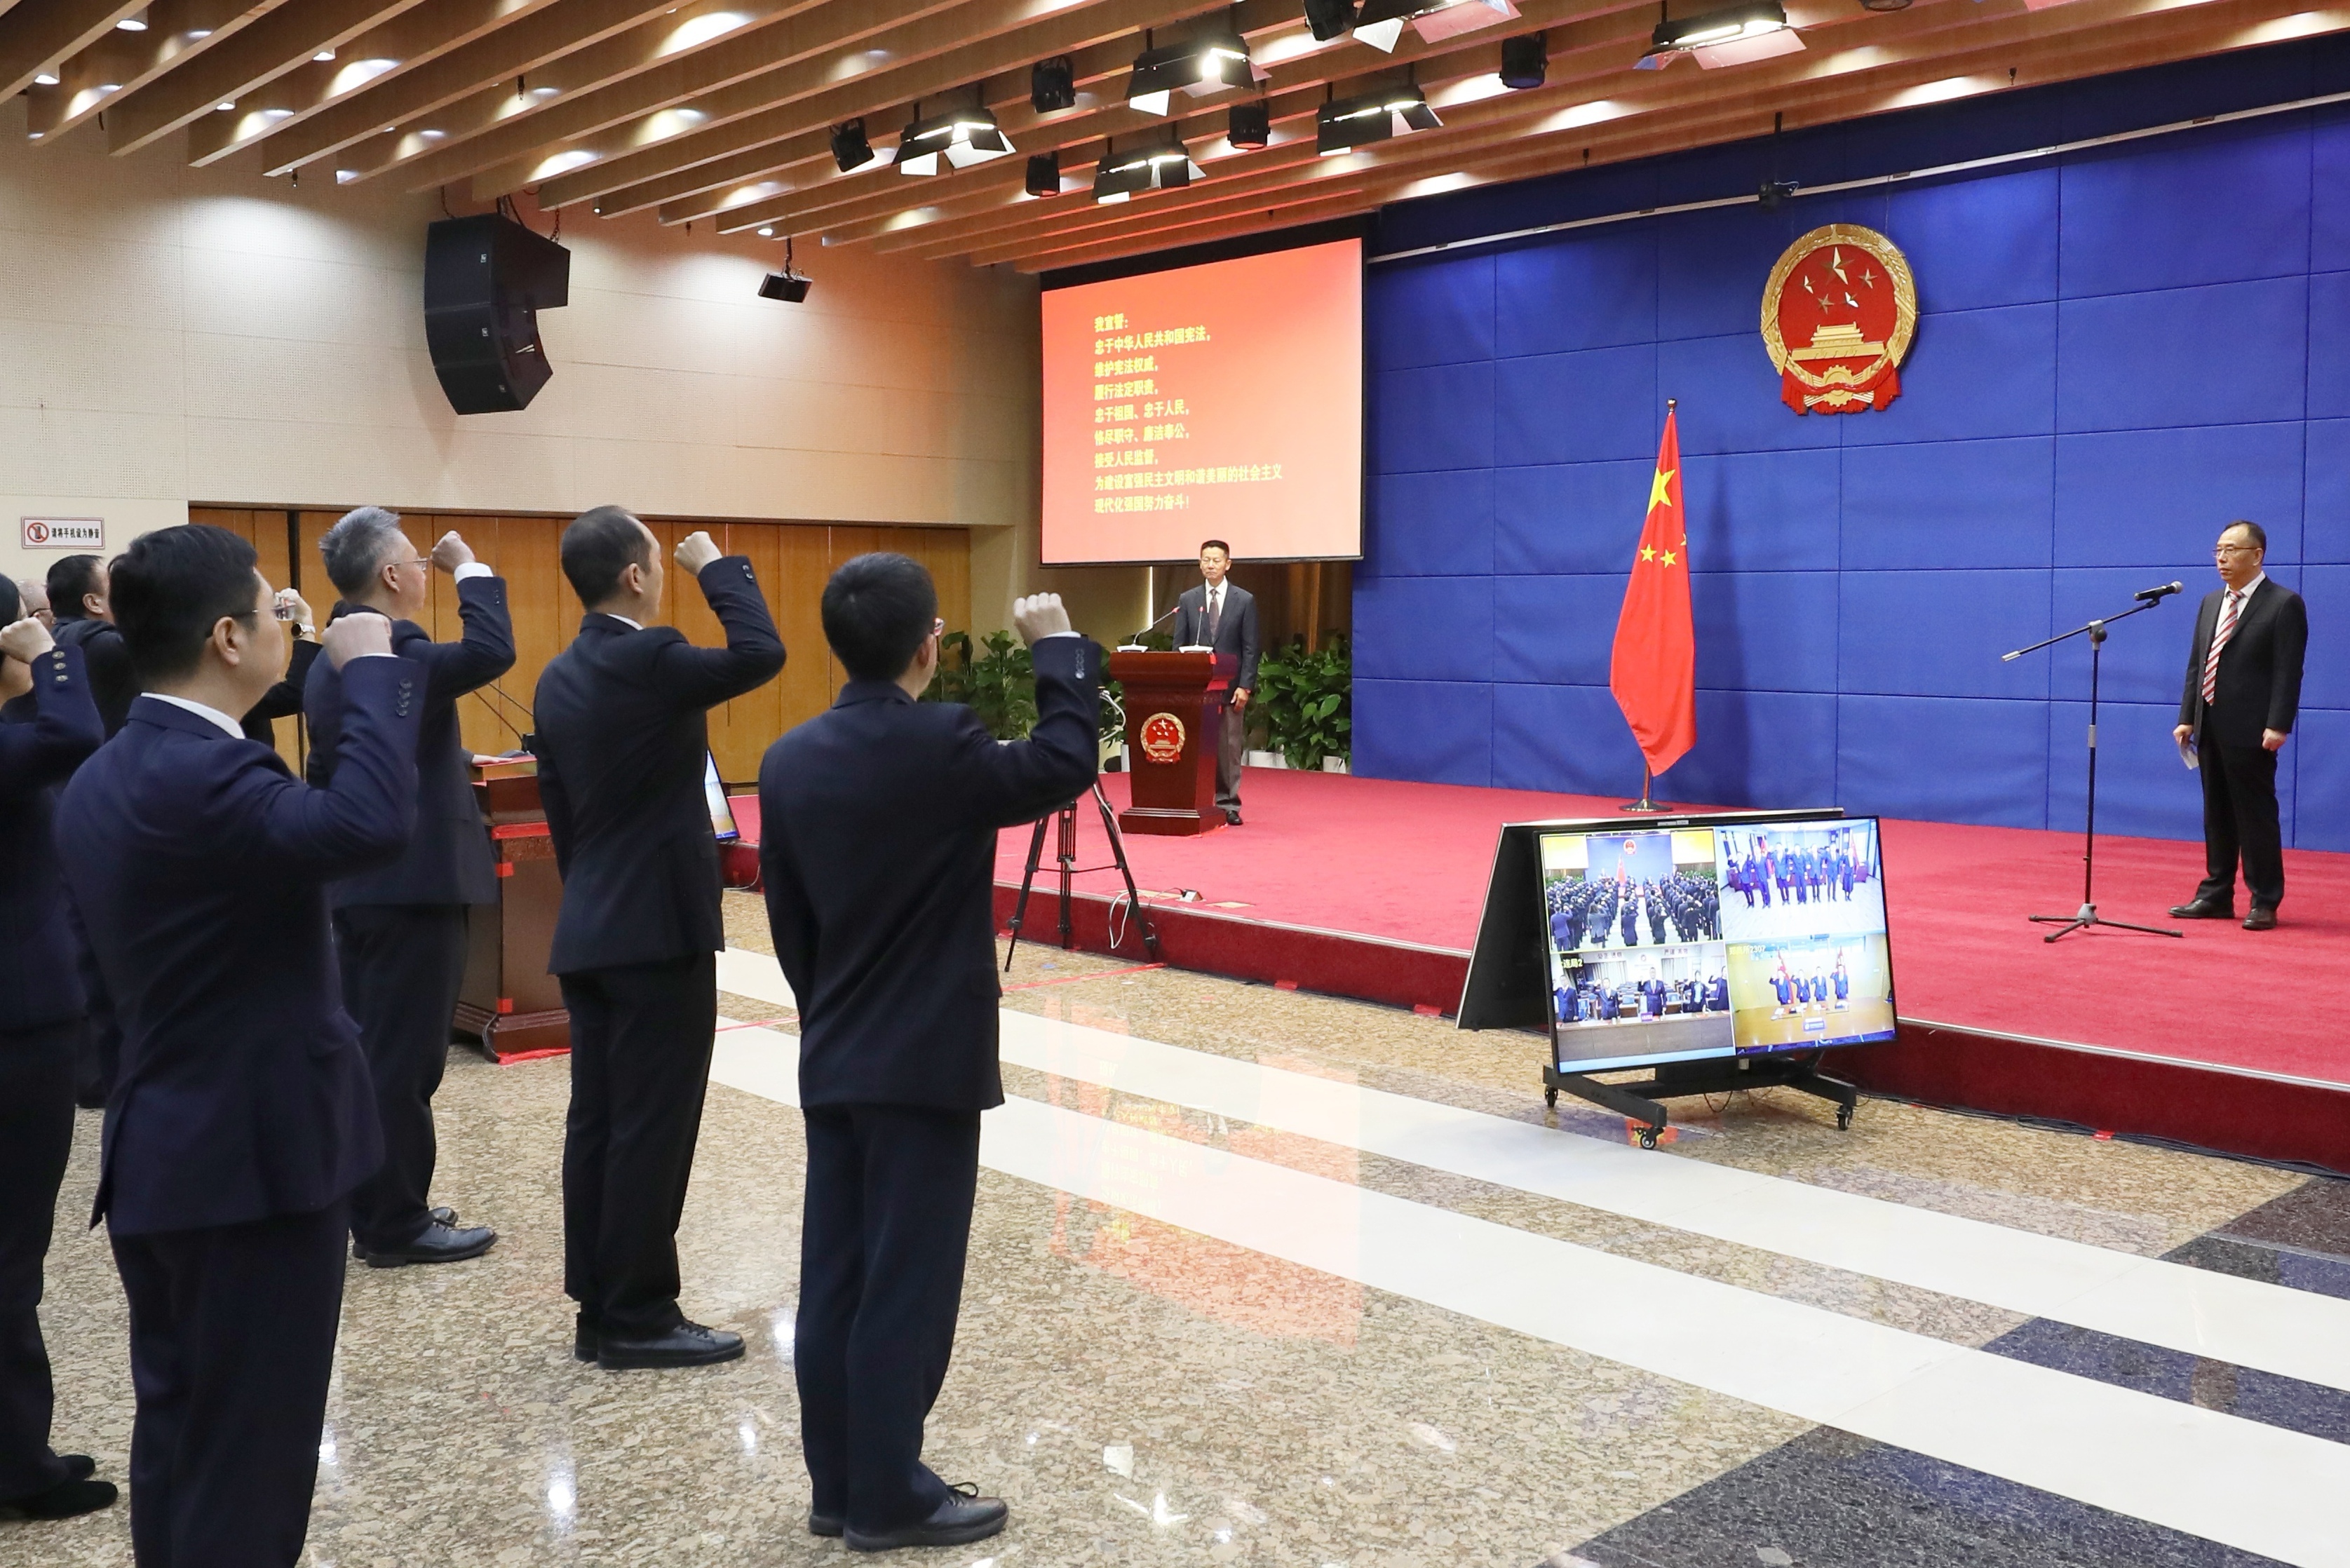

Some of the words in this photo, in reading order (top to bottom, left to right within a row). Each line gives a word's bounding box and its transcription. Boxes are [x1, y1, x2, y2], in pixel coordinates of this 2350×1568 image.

[1095, 464, 1283, 491] 为建设富强民主文明和谐美丽的社会主义
[51, 527, 100, 539] 请将手机设为静音
